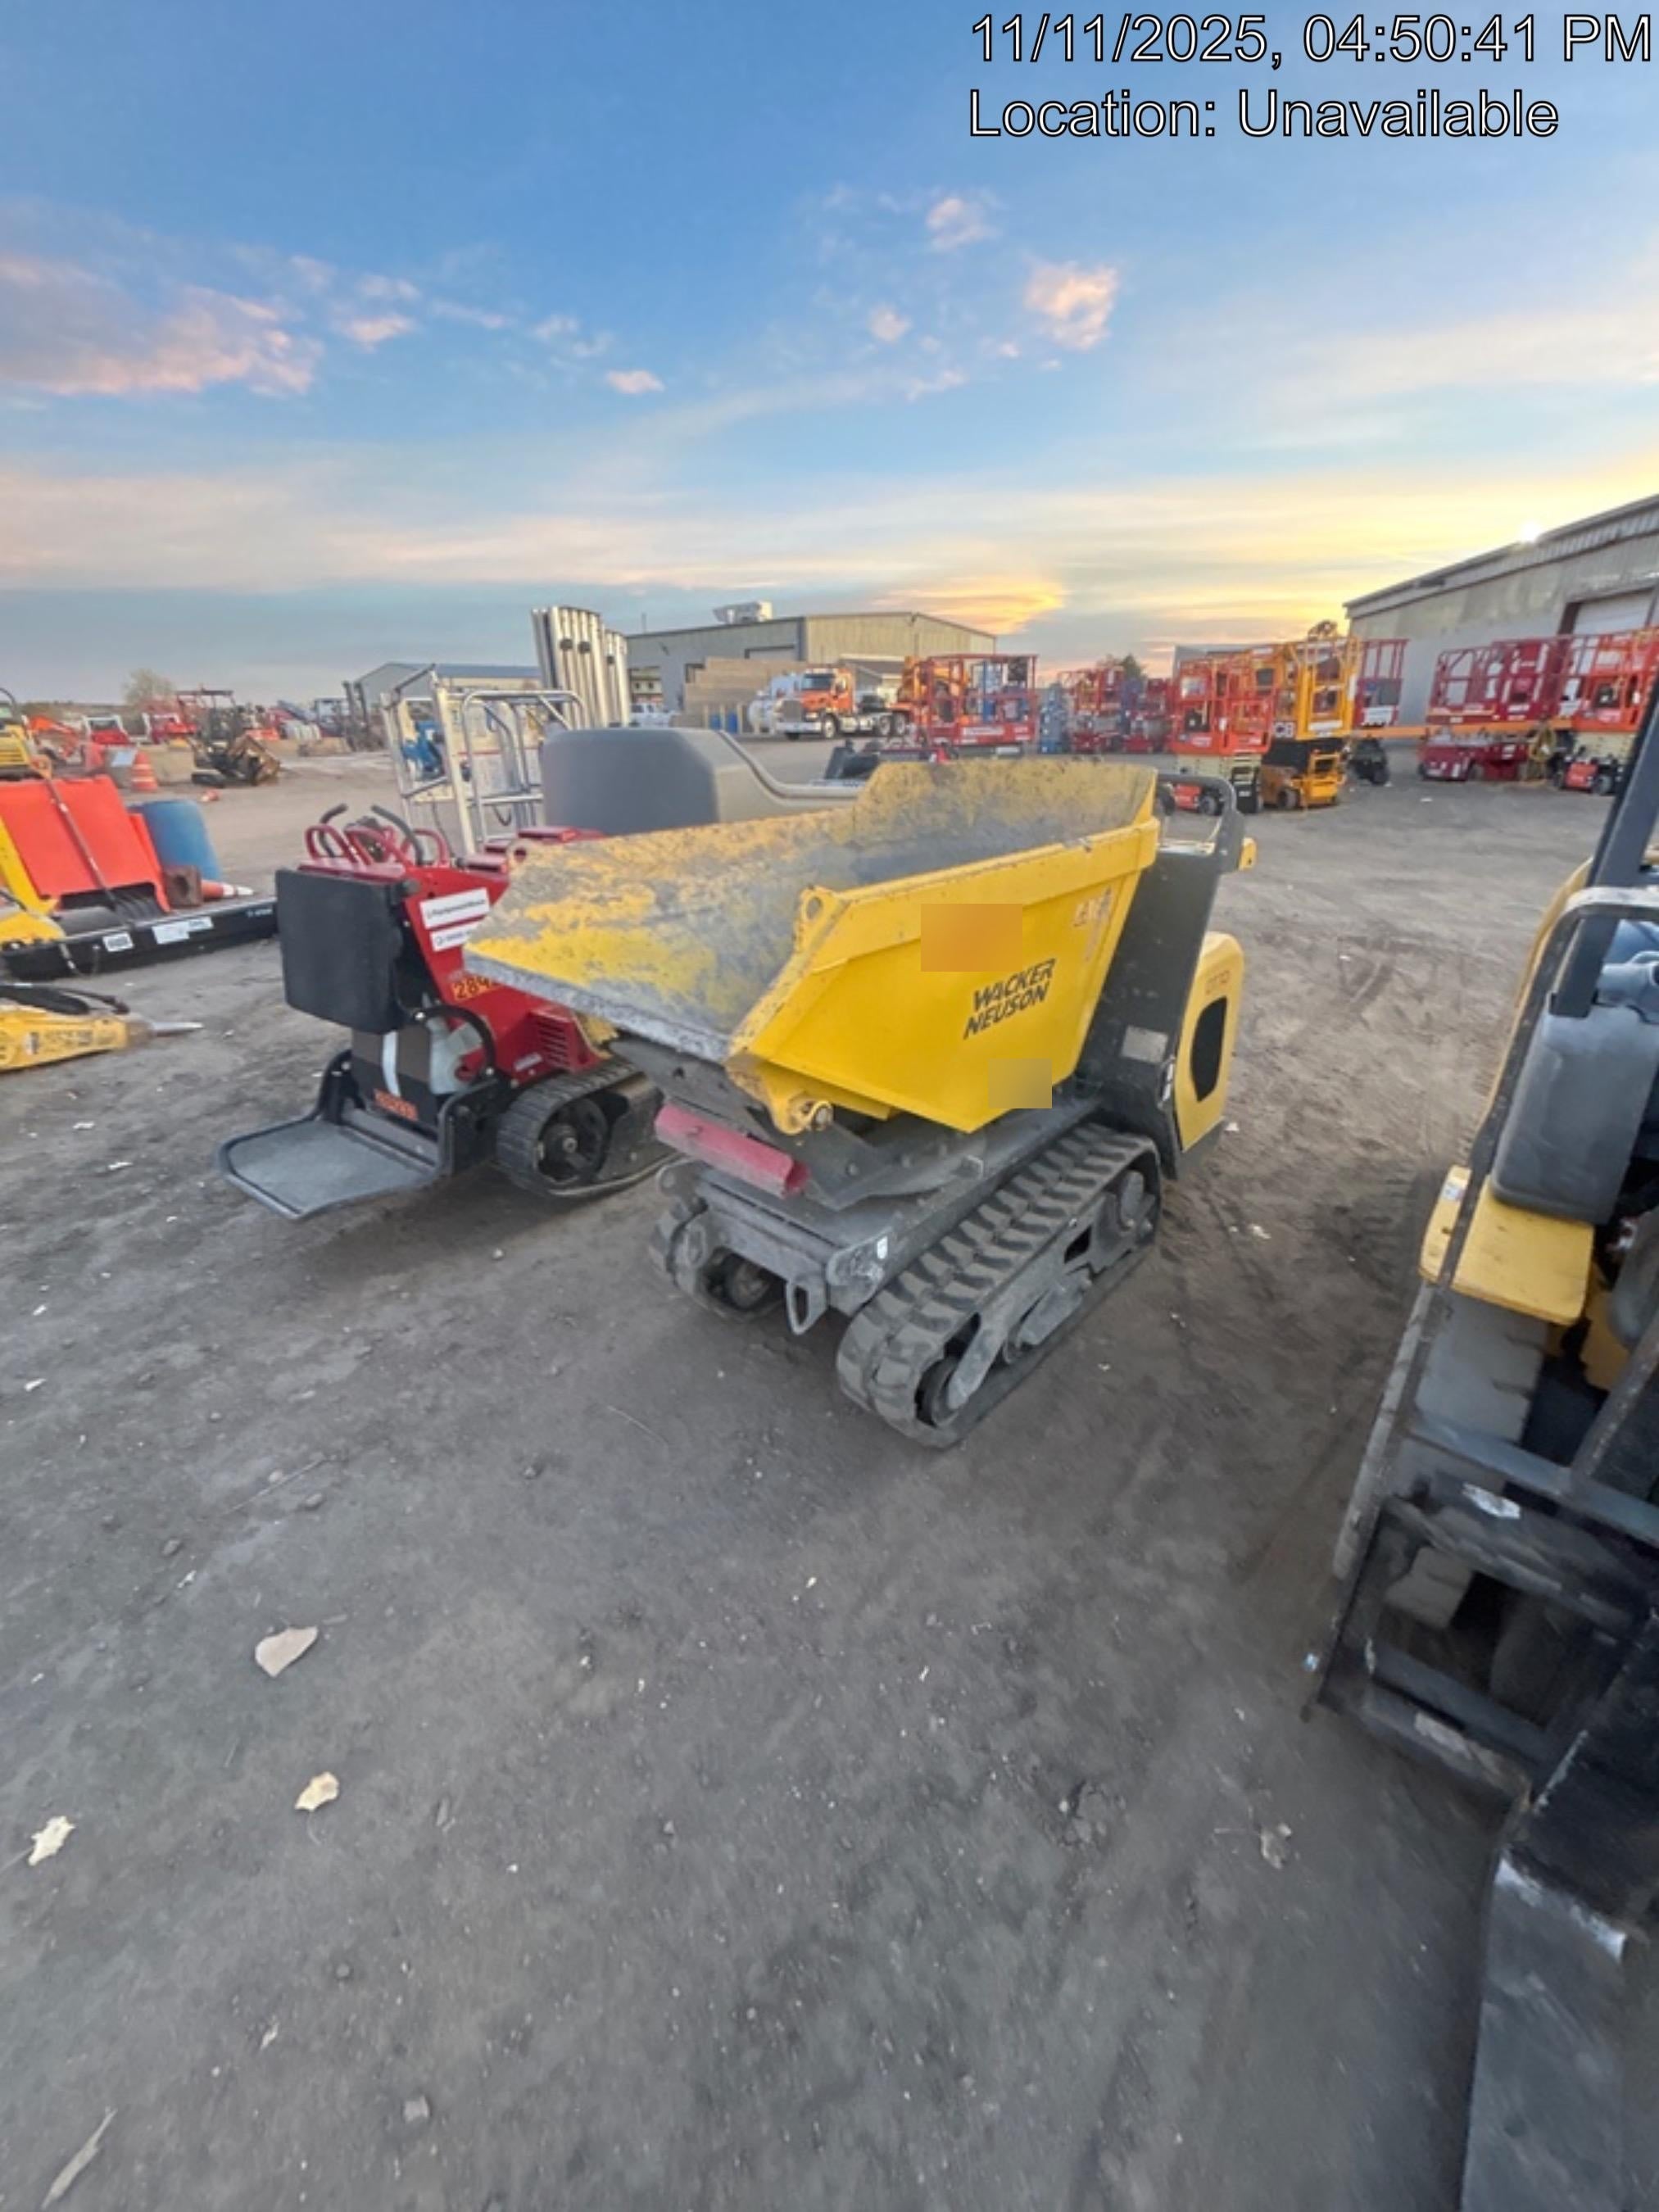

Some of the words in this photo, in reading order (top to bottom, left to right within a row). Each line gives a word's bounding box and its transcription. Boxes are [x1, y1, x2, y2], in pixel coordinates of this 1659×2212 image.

[1275, 722, 1294, 738] CB
[963, 980, 1049, 1040] NEUSON
[974, 957, 1055, 1012] WACKER
